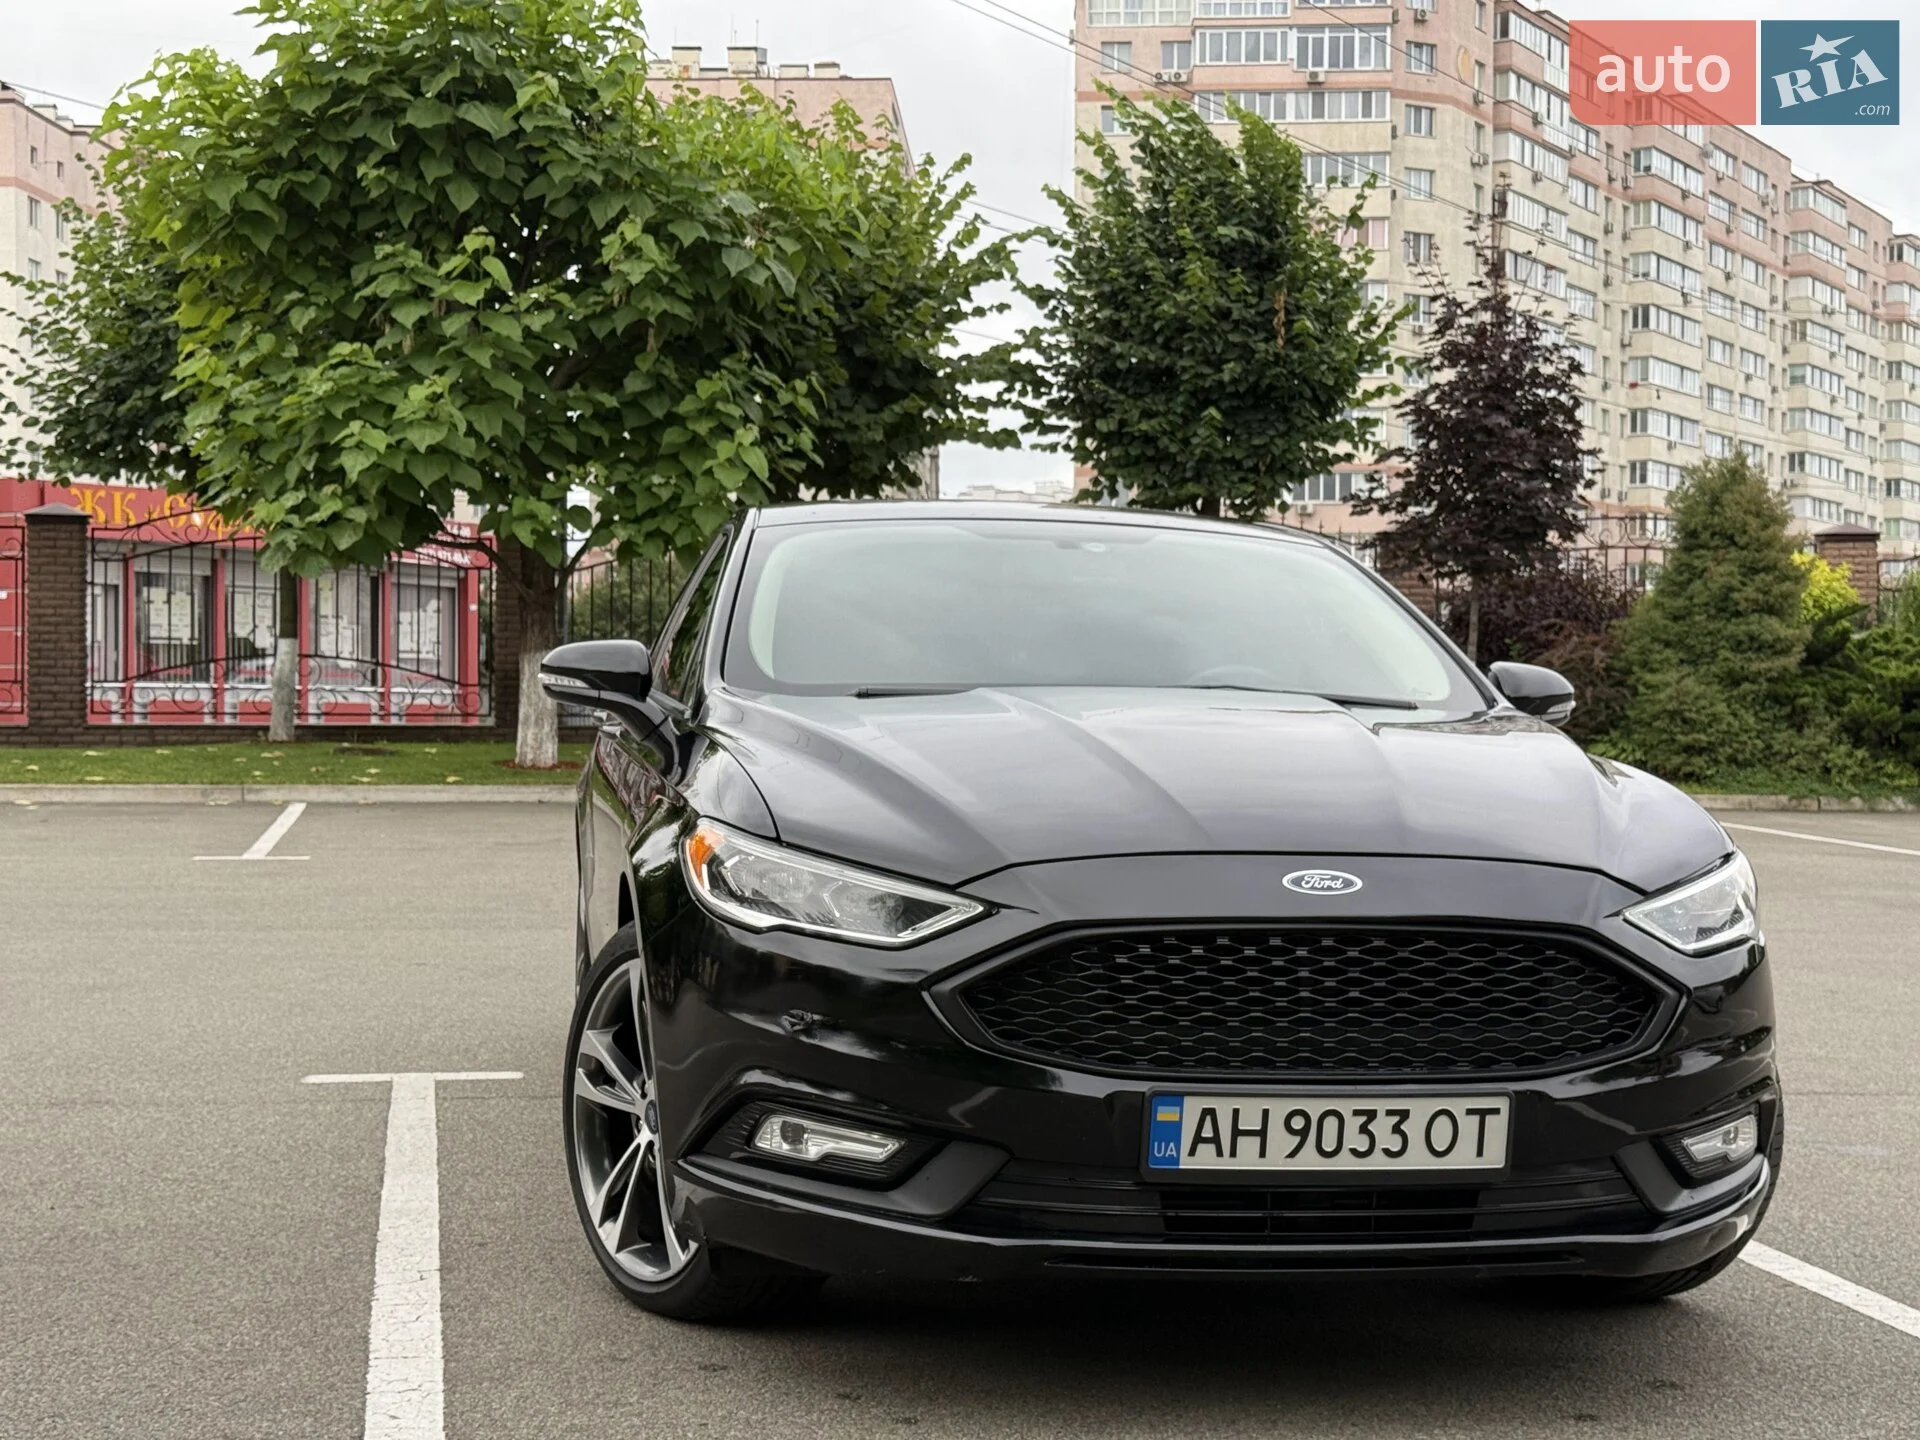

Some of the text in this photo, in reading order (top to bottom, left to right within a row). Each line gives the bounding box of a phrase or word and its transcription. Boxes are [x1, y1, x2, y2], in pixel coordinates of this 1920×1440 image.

[69, 487, 137, 527] ЖК
[1301, 874, 1344, 889] Ford
[1187, 1106, 1501, 1160] AH 9033 OT
[1153, 1141, 1177, 1158] UA
